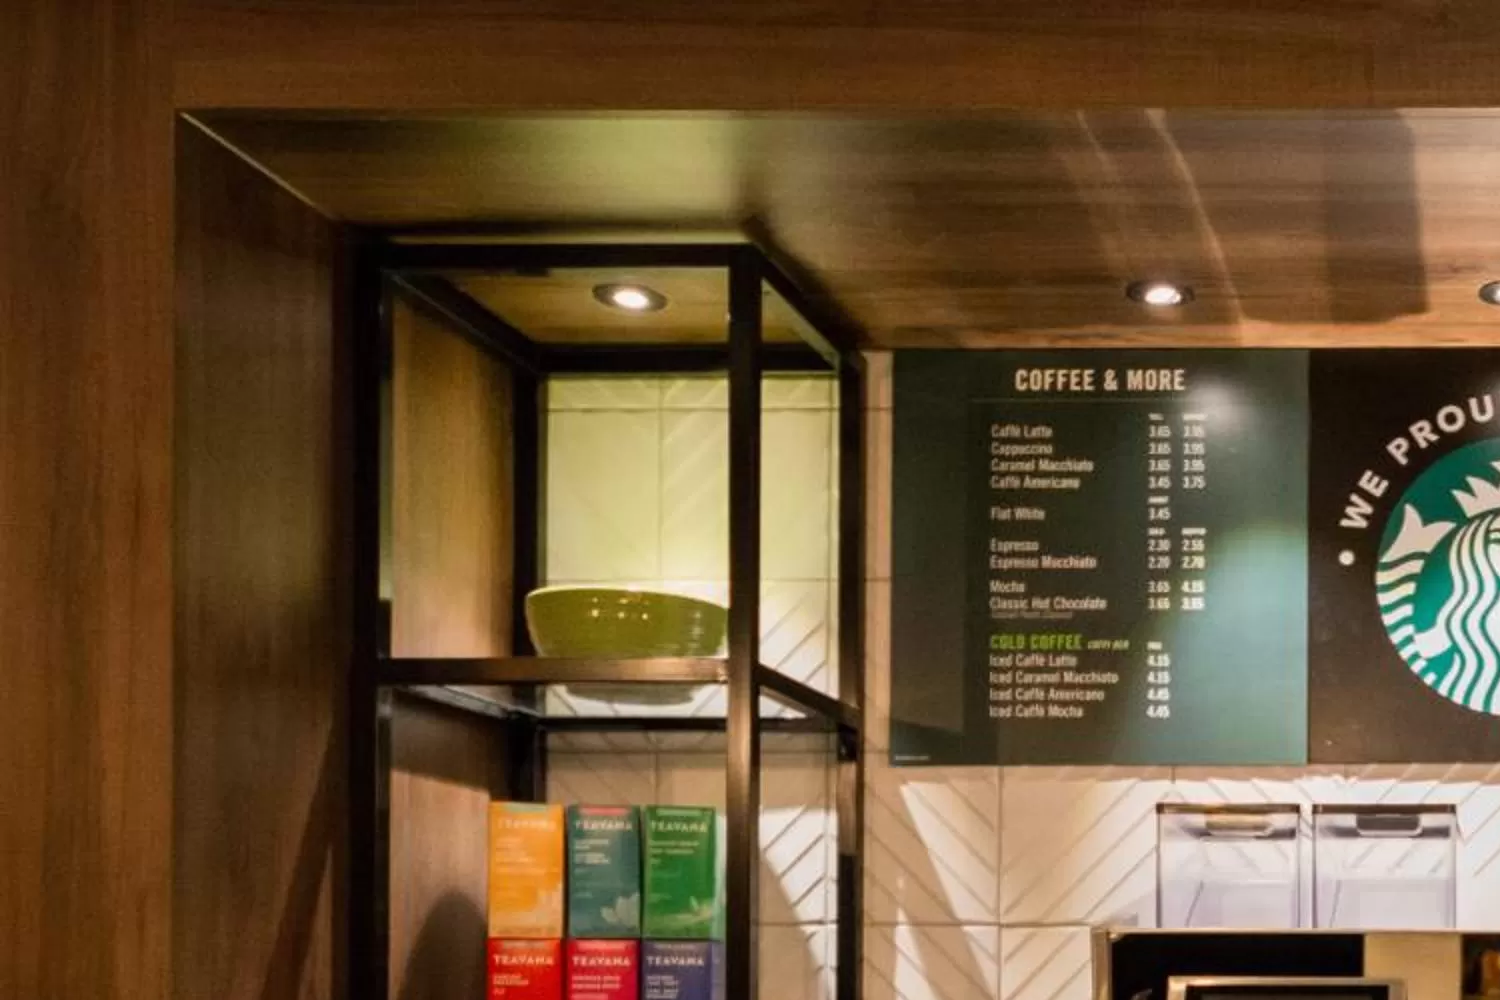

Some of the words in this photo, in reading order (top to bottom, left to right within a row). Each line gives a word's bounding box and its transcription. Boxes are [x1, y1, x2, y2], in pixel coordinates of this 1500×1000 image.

[1015, 369, 1095, 391] COFFEE
[1103, 369, 1118, 391] &
[1127, 369, 1186, 391] MORE
[1023, 425, 1053, 437] Latte
[990, 442, 1053, 456] Cappuccino
[990, 459, 1037, 472] Caramel
[1039, 459, 1094, 472] Macchiato
[1023, 476, 1081, 488] Americano
[1339, 469, 1390, 530] WE
[990, 508, 1013, 520] Flat
[1014, 508, 1045, 520] White
[990, 539, 1039, 552] Espresso
[989, 556, 1039, 569] Espresso
[1041, 556, 1097, 569] Macchiato
[990, 580, 1025, 593] Mocha
[989, 597, 1028, 610] Classic
[1032, 597, 1052, 610] Hot
[1054, 597, 1107, 610] Chocolate
[990, 634, 1026, 649] COLD
[1031, 634, 1083, 649] COFFEE
[990, 655, 1012, 667] Iced
[1049, 655, 1077, 667] Latte
[990, 672, 1012, 684] Iced
[1016, 672, 1061, 684] Caramel
[1063, 672, 1119, 684] Macchiato
[990, 689, 1012, 701] Iced
[1047, 689, 1105, 701] Americano
[990, 705, 1012, 717] Iced
[1048, 705, 1083, 717] Mocha
[650, 820, 708, 833] TEAVANA
[494, 954, 554, 966] TEAVANA
[573, 956, 632, 966] TEAVANA
[647, 956, 705, 966] TEAVANA
